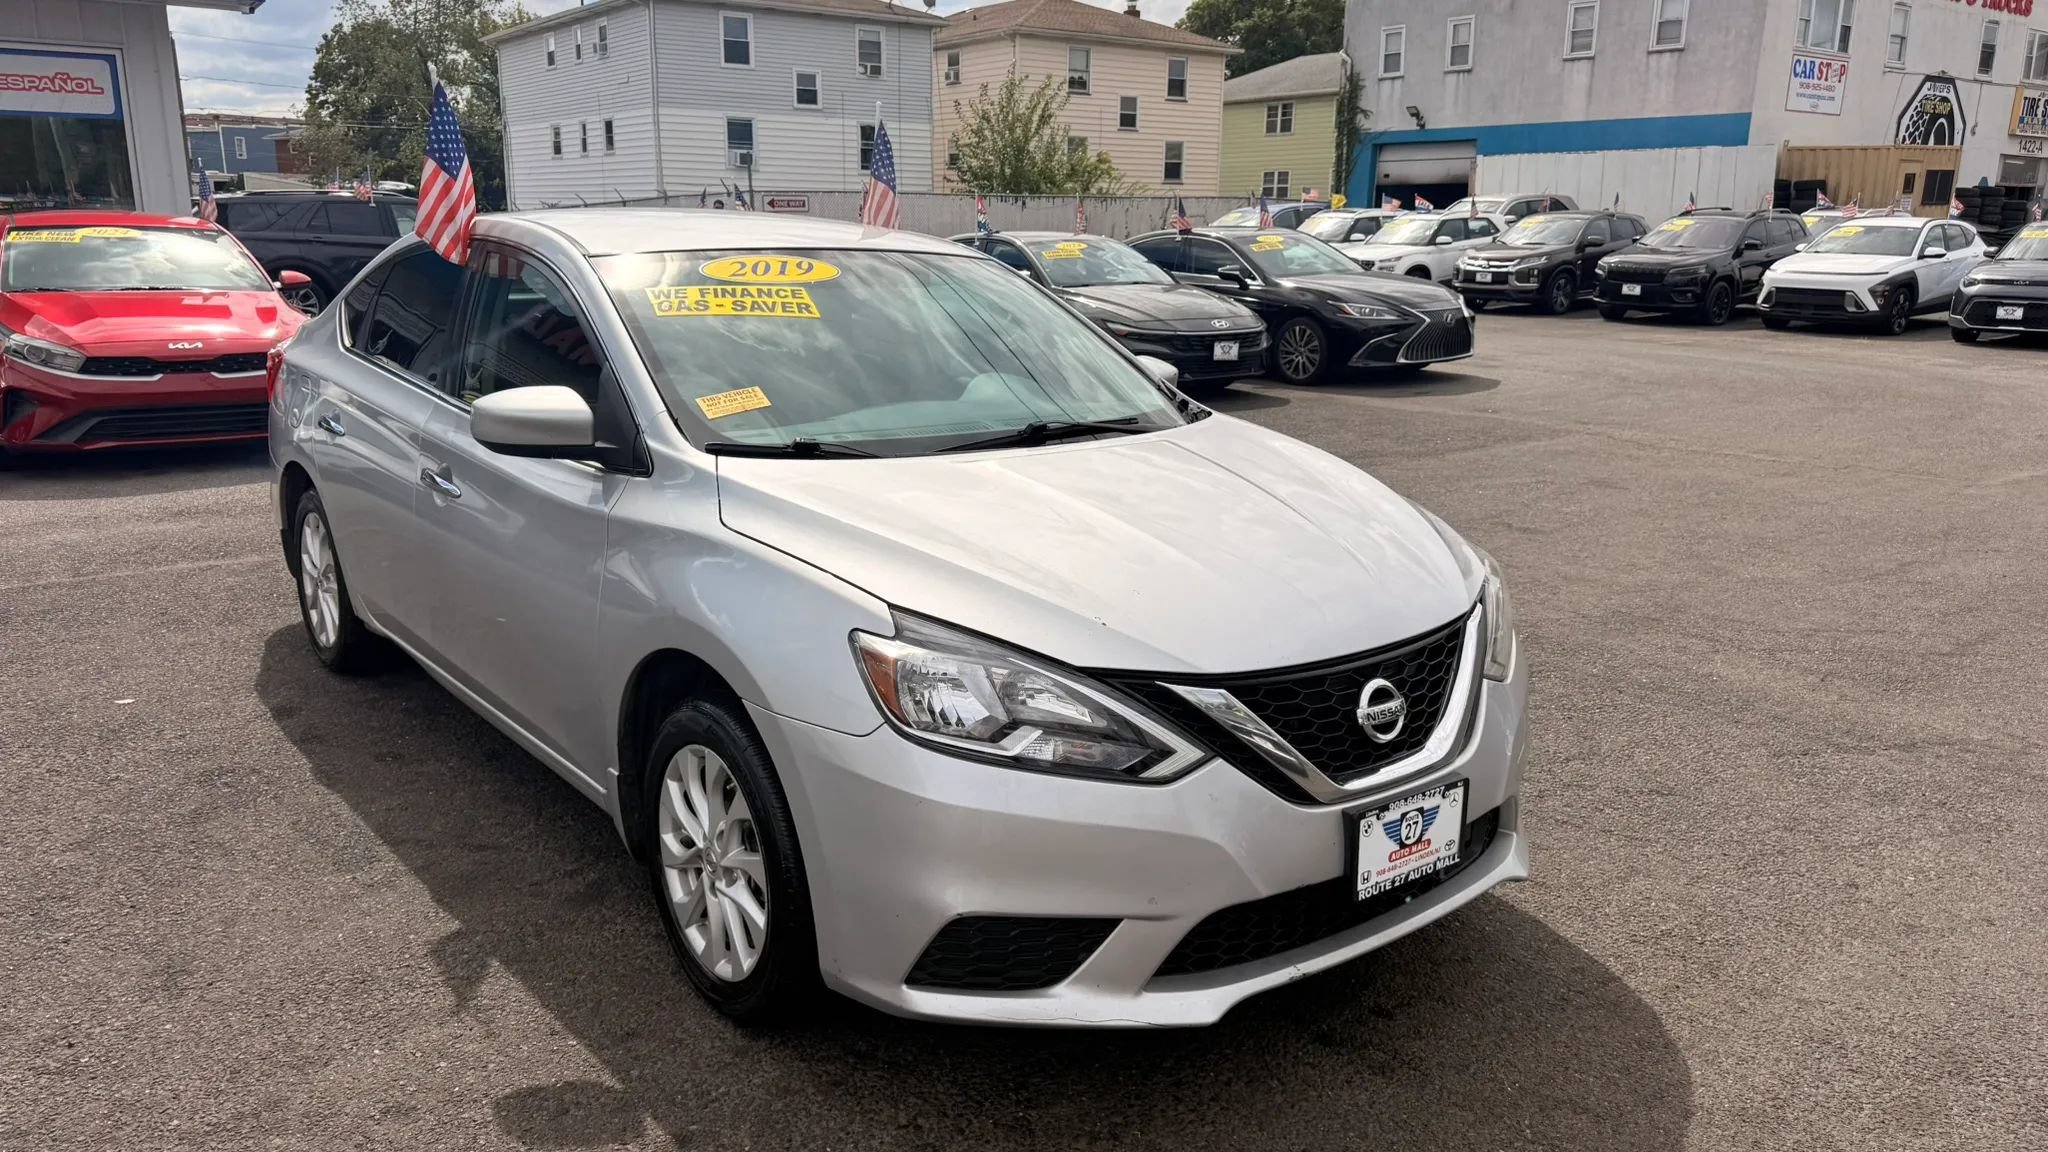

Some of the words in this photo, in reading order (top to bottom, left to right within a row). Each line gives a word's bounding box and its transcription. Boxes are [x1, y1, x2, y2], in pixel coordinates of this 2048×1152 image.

[1793, 58, 1815, 80] CAR
[1922, 100, 1935, 113] TIRE
[1935, 101, 1951, 114] SHOP
[2021, 96, 2041, 117] TIRE
[2018, 139, 2043, 154] 1422-A
[728, 260, 814, 277] 2019
[651, 288, 688, 299] WE
[698, 288, 804, 299] FINANCE
[657, 300, 709, 312] GAS
[731, 300, 815, 314] SAVER
[701, 395, 722, 404] THIS
[722, 388, 759, 399] VEHICLE
[1366, 703, 1405, 721] NISSAN
[1388, 786, 1445, 810] 908-648-2727
[1405, 814, 1420, 823] ROUTE
[1404, 821, 1419, 841] 27
[1391, 849, 1410, 860] AUTO
[1411, 841, 1429, 853] MALL
[1358, 880, 1392, 900] ROUTE
[1394, 874, 1406, 887] 27
[1408, 863, 1434, 881] AUTO
[1436, 854, 1460, 871] MALL
